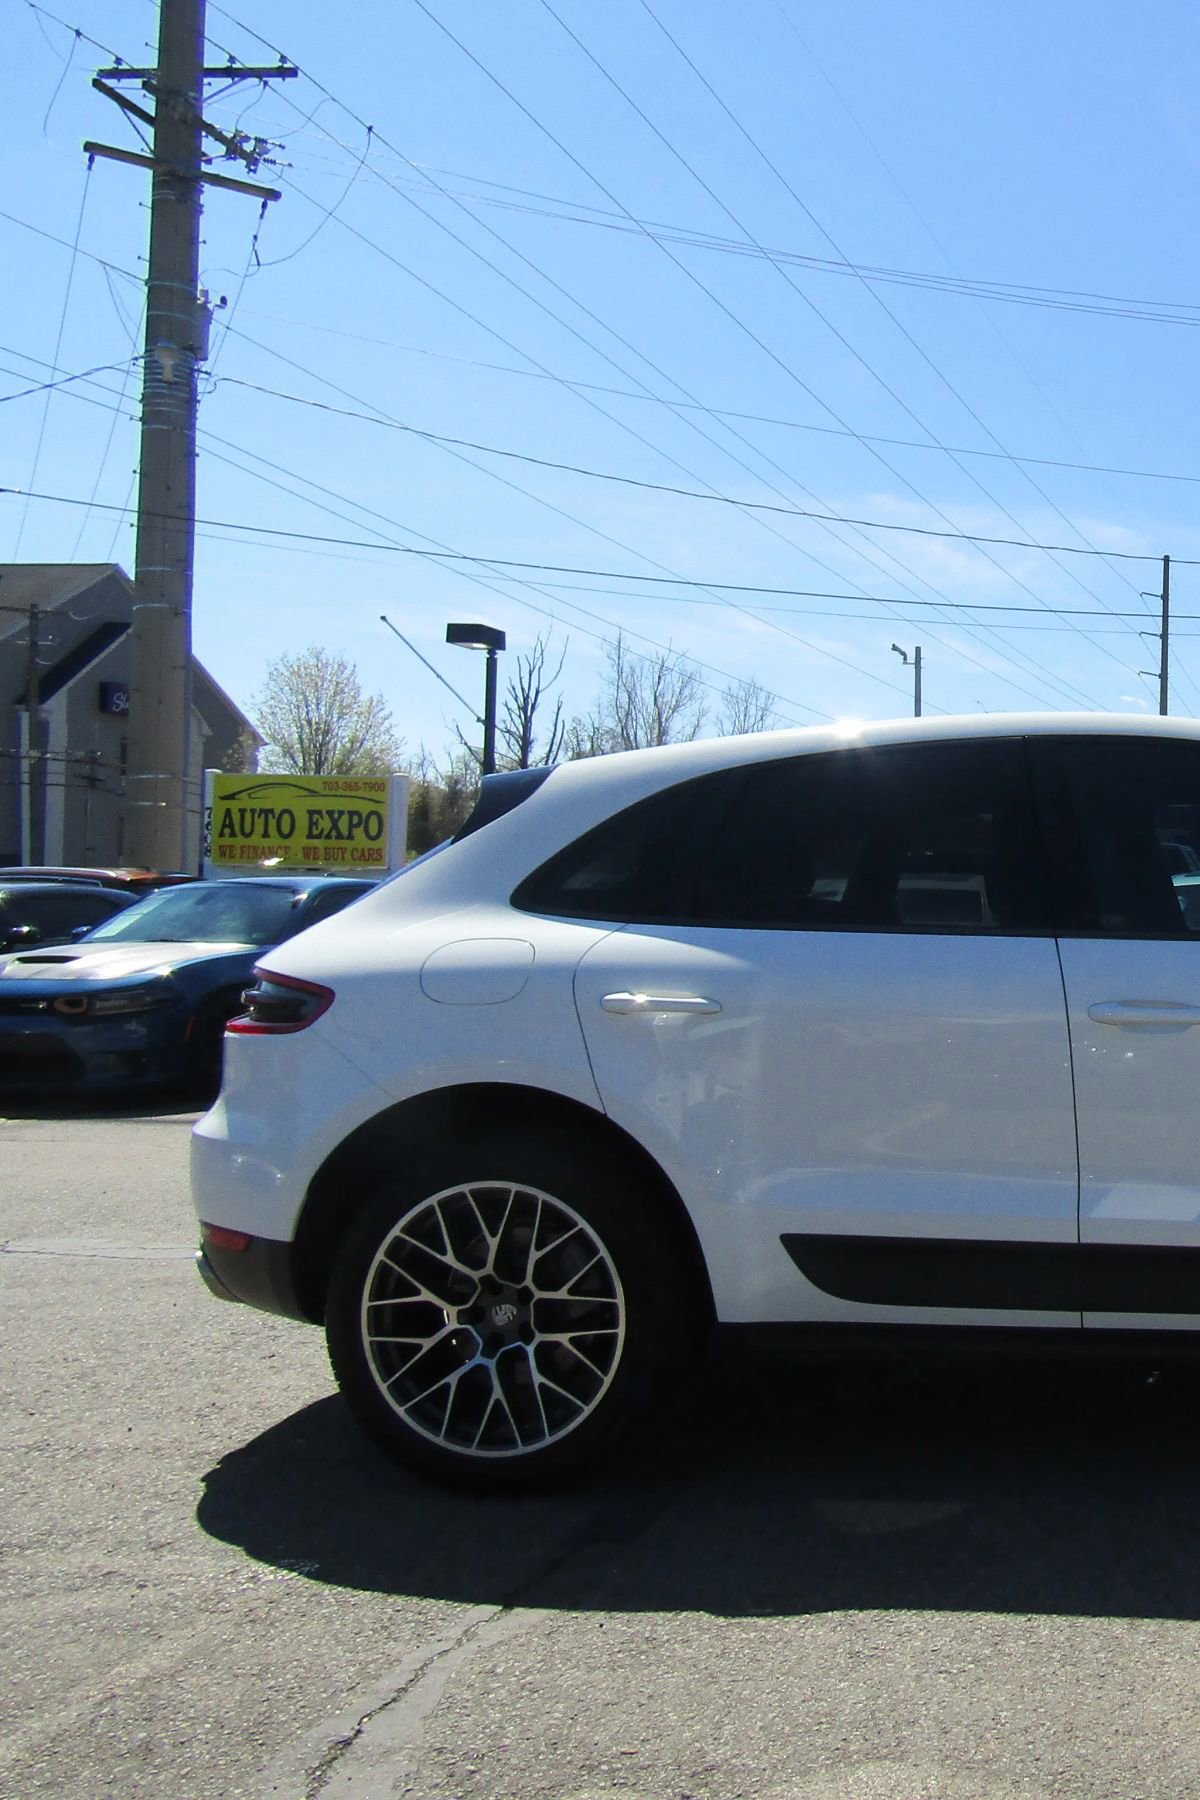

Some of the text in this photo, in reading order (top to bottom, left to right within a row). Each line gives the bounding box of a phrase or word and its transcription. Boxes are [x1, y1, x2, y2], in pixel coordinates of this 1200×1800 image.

[218, 807, 384, 841] AUTO EXPO
[218, 844, 383, 862] WE FINANCE WE BUY CARS
